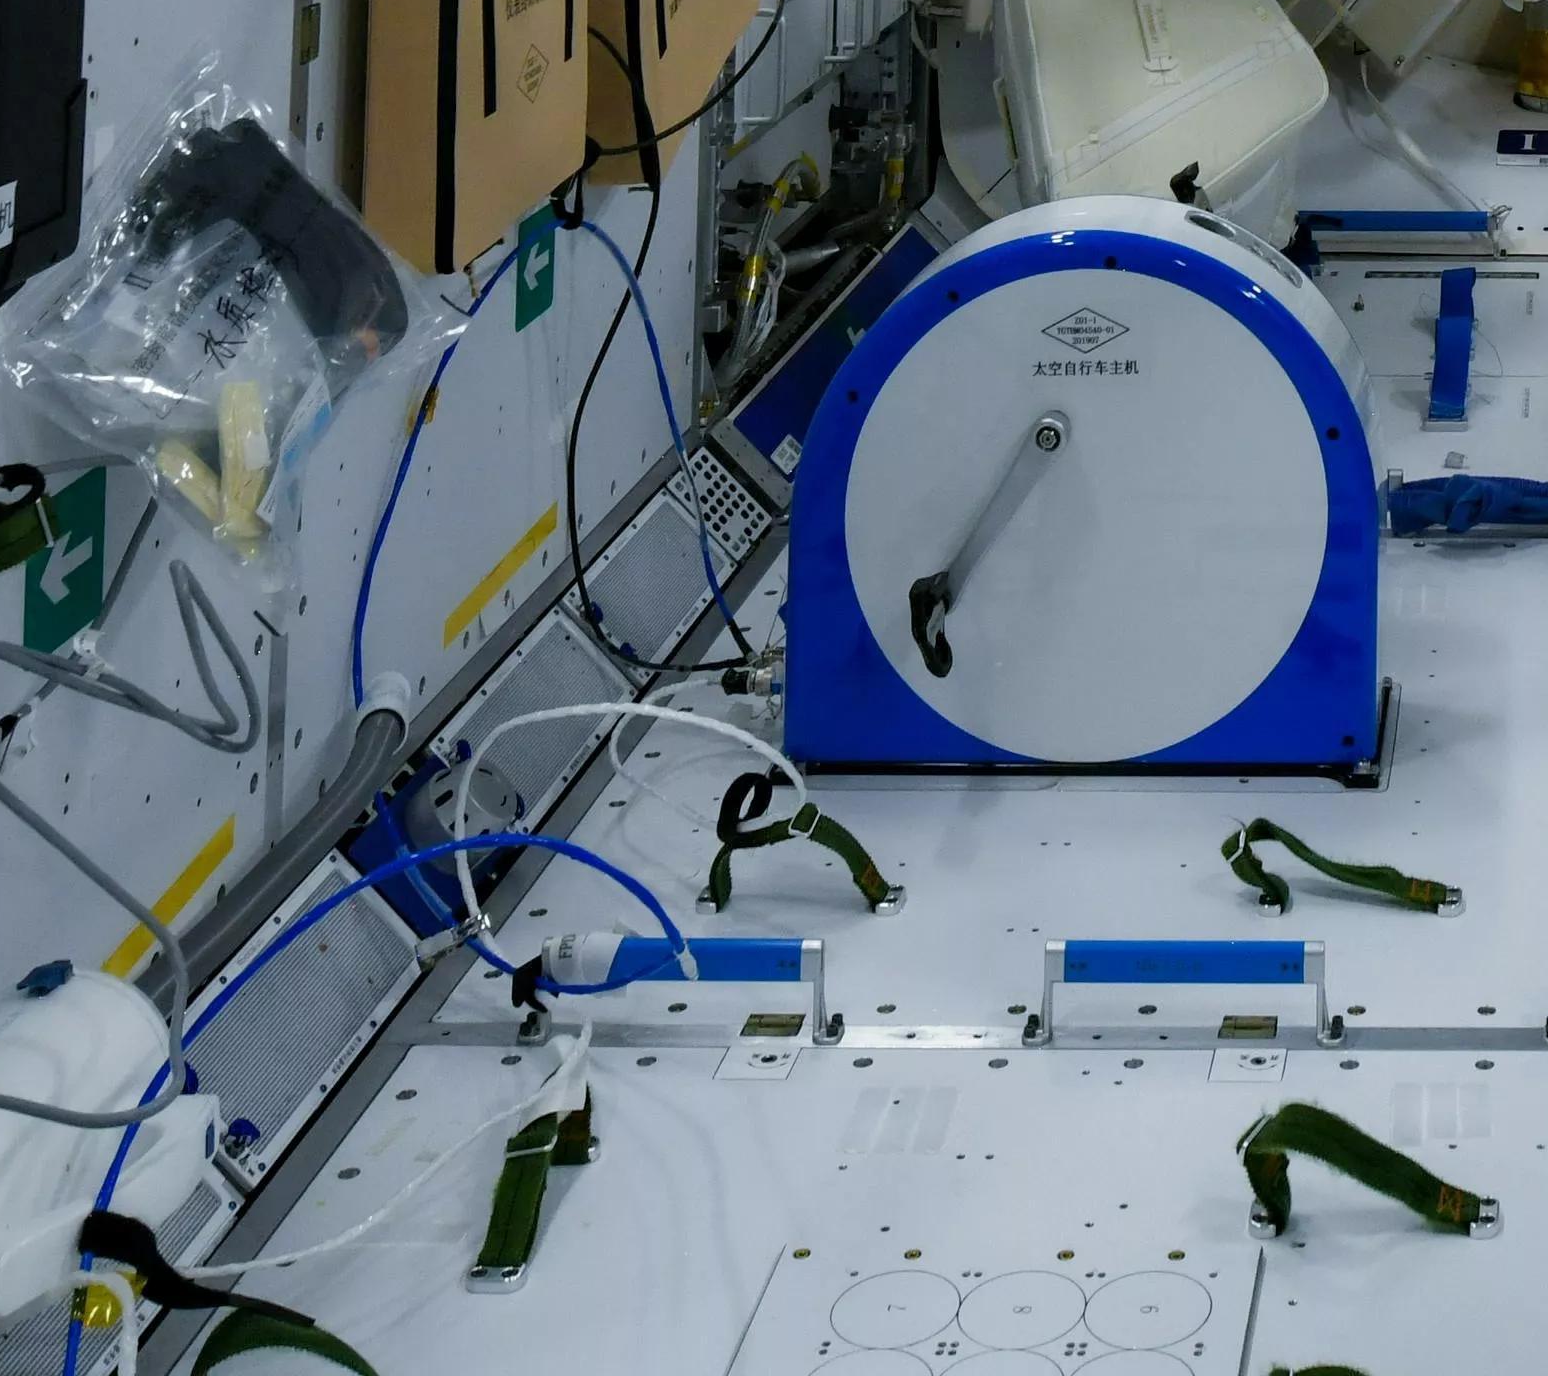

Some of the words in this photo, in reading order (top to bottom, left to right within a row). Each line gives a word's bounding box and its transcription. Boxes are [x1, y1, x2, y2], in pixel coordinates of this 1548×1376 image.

[1521, 133, 1535, 152] I
[1032, 359, 1140, 378] 太空自行车主机
